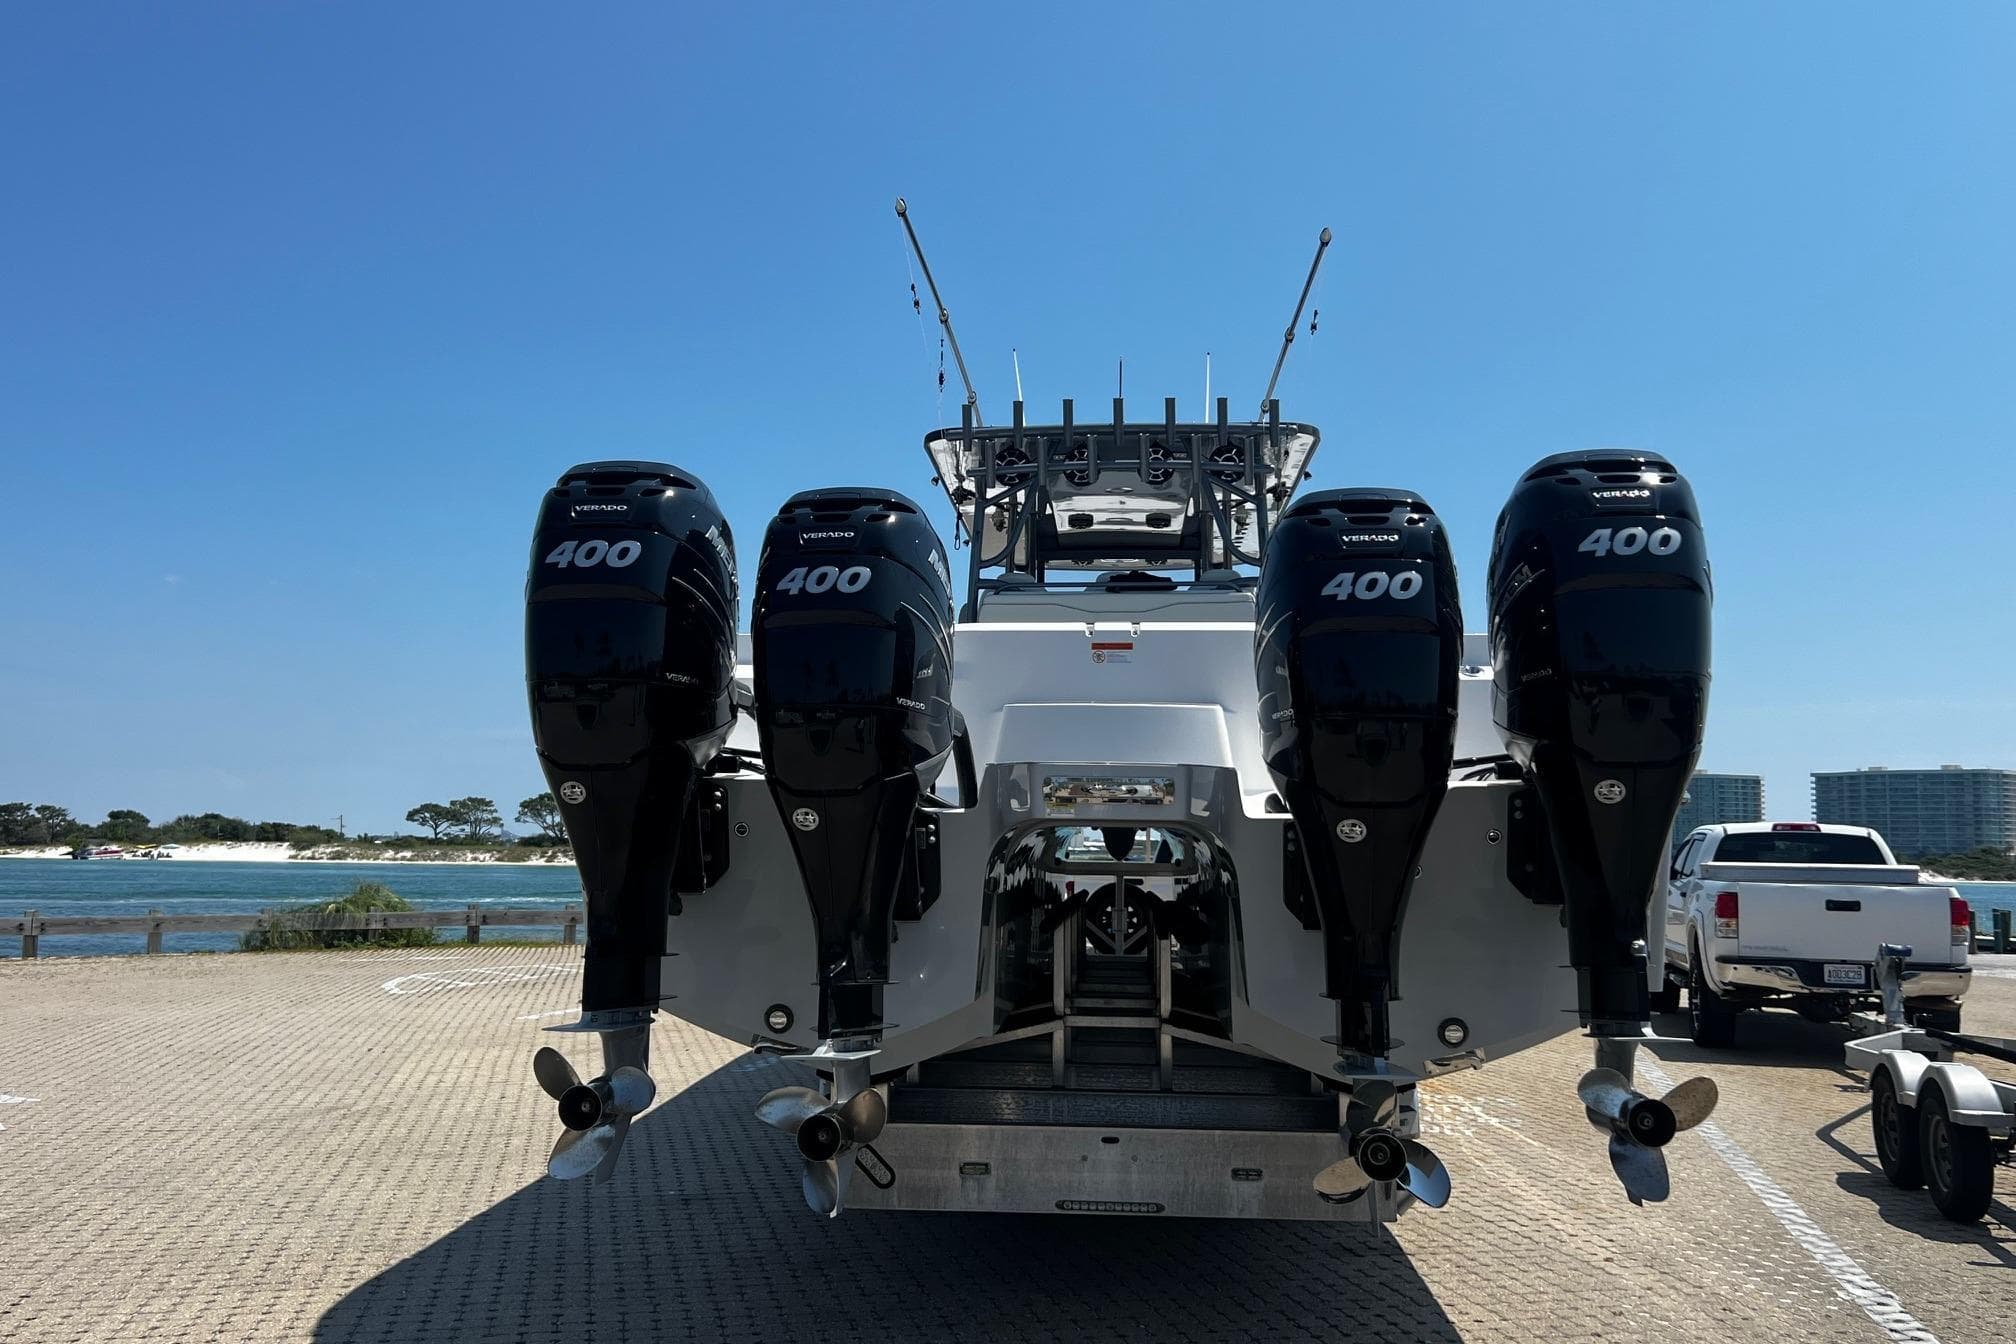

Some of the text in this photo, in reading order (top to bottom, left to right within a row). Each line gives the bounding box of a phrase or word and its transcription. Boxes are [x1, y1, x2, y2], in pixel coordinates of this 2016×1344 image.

[1592, 489, 1651, 498] VERADO
[803, 531, 855, 539] VERADO
[1342, 534, 1400, 542] VERADO
[1577, 526, 1682, 557] 400
[545, 539, 642, 568] 400
[776, 565, 872, 595] 400
[1321, 570, 1423, 601] 400
